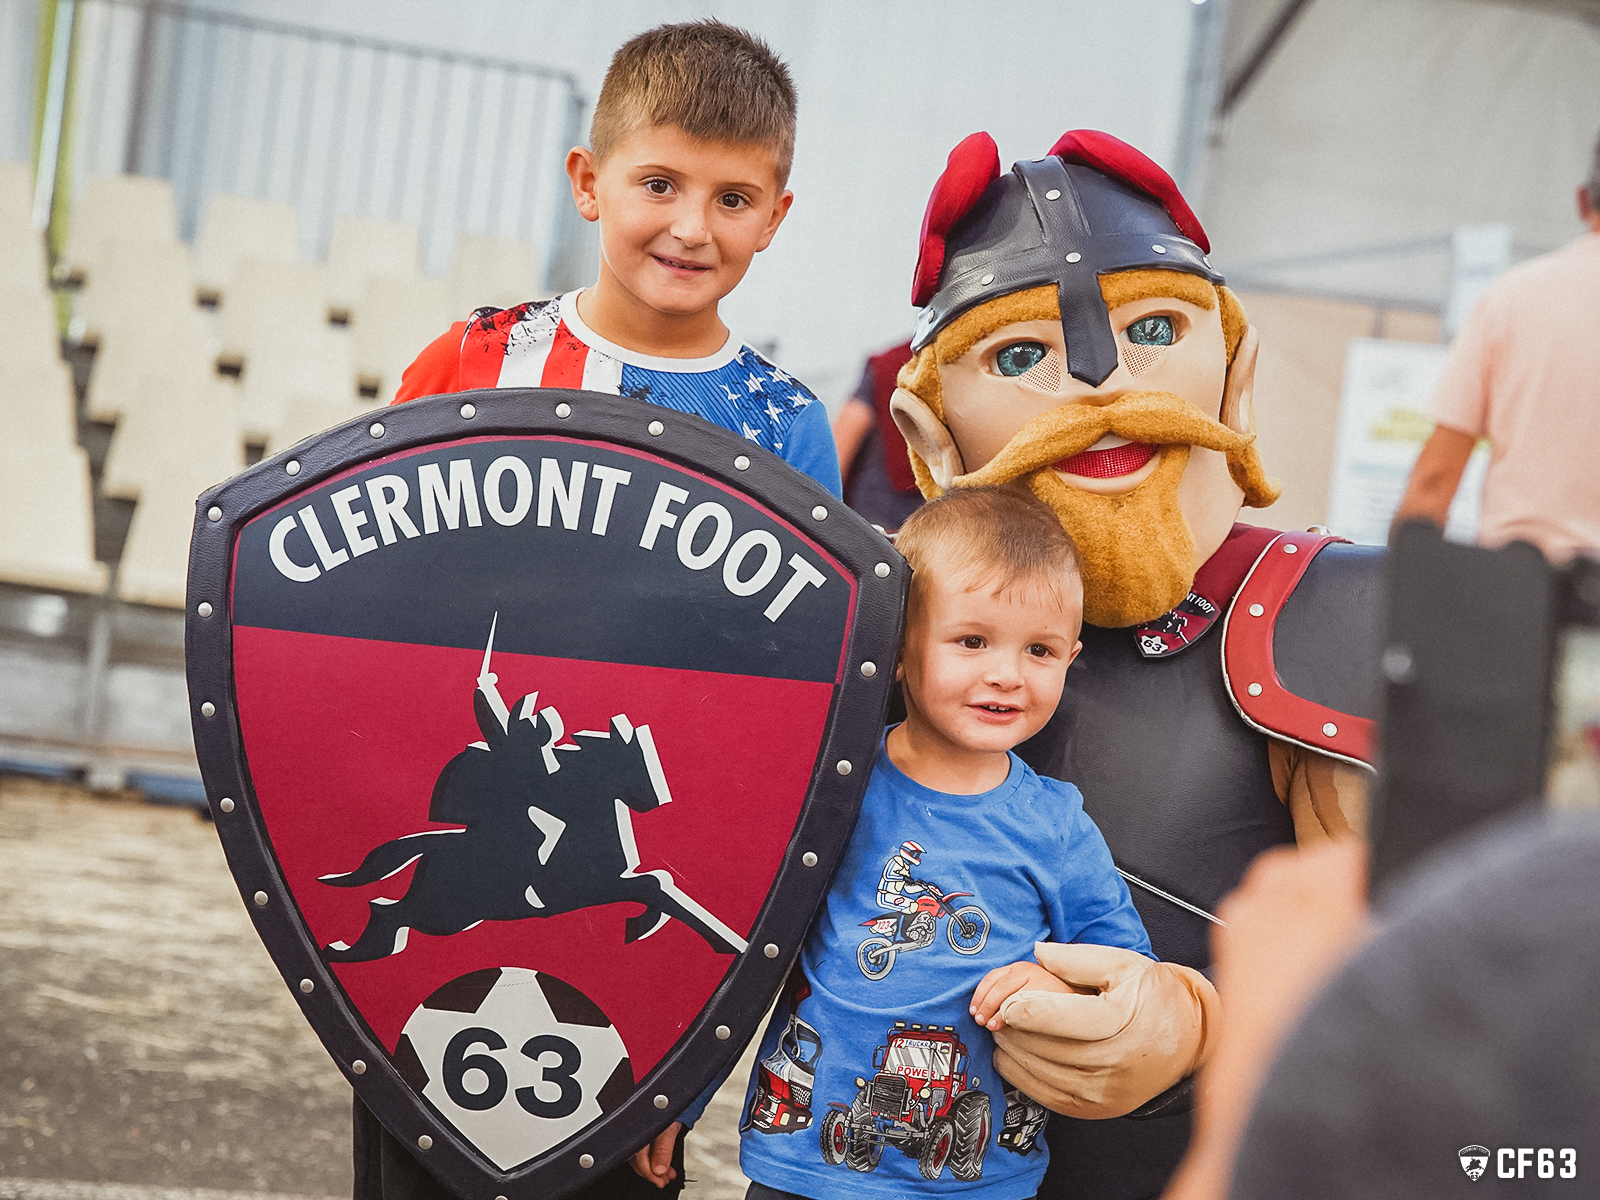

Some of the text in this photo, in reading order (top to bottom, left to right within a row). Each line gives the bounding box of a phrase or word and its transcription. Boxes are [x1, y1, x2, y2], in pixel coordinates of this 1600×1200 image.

[267, 455, 827, 622] CLERMONT FOOT
[1194, 596, 1215, 613] FOOT
[1143, 639, 1162, 652] 63
[877, 920, 891, 930] 123
[893, 1038, 905, 1048] 12
[442, 1026, 583, 1120] 63
[896, 1065, 936, 1079] POWER
